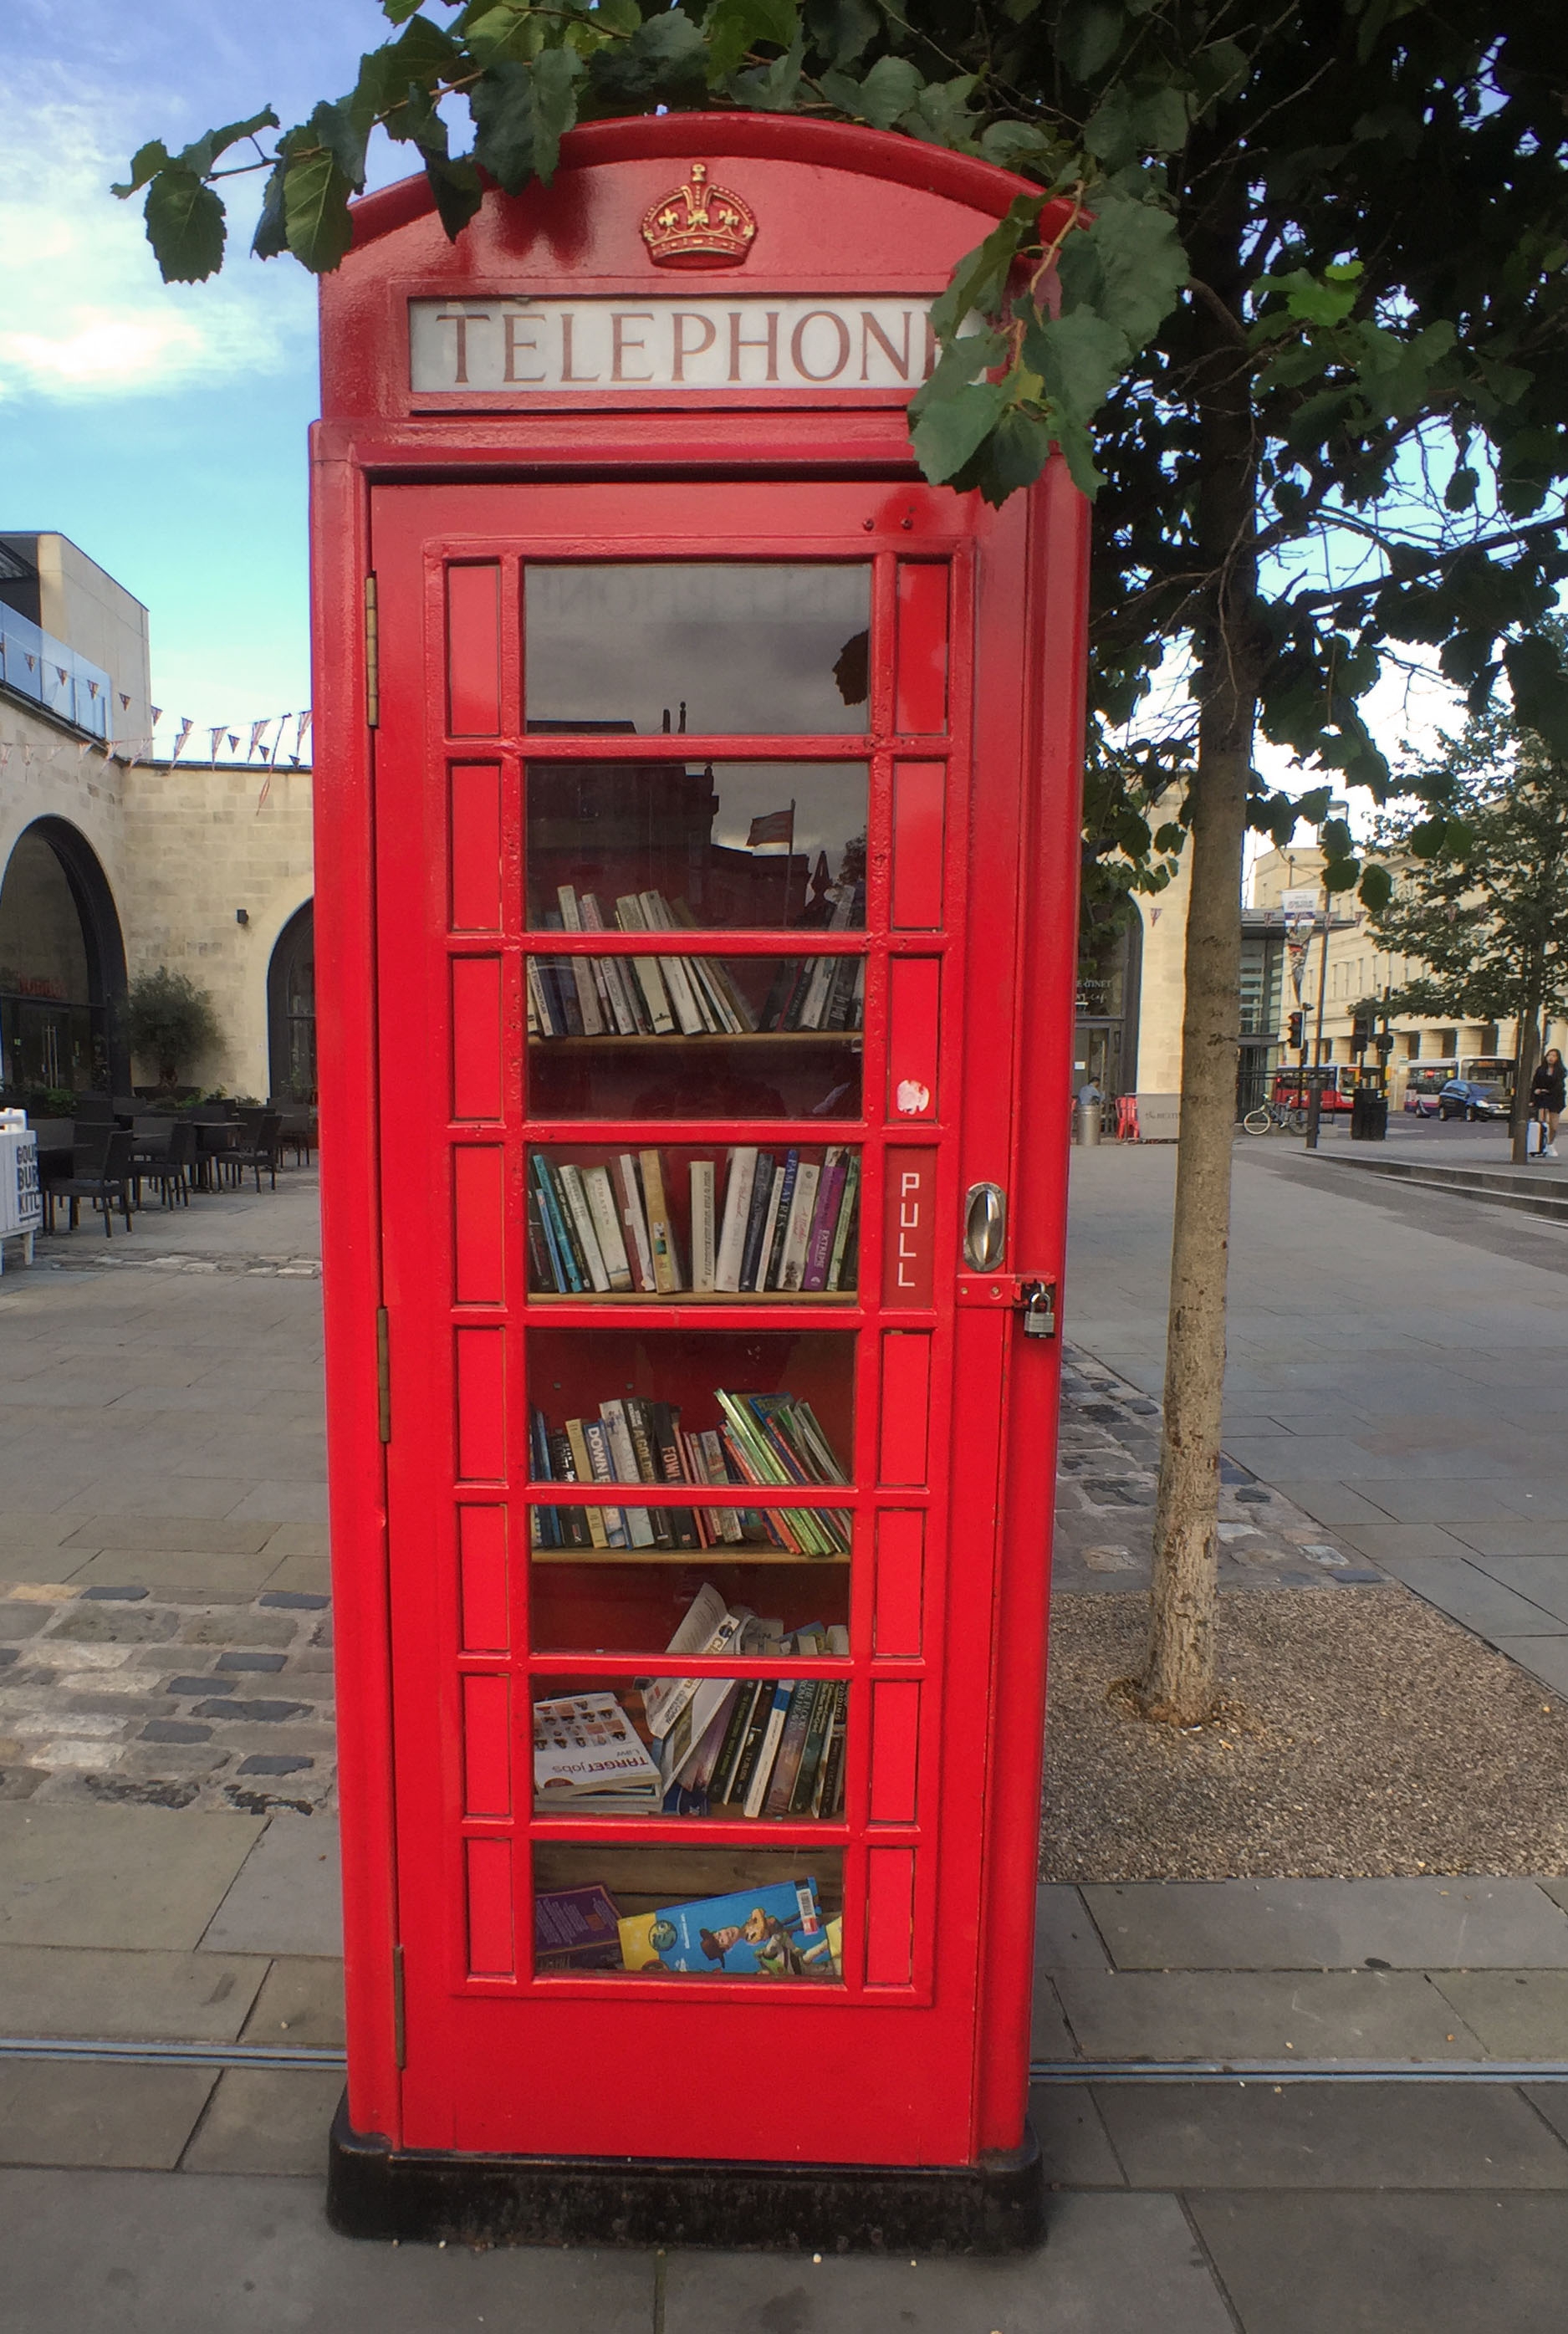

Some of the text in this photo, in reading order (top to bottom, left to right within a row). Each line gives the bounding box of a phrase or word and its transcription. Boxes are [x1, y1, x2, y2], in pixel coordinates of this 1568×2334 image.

[17, 1144, 38, 1165] GOU
[784, 1158, 797, 1184] PAM
[777, 1187, 791, 1228] AYRES
[819, 1229, 830, 1269] EXTREME
[898, 1172, 920, 1287] PULL
[587, 1426, 609, 1473] DOWN
[552, 1755, 649, 1774] TARGETjobs
